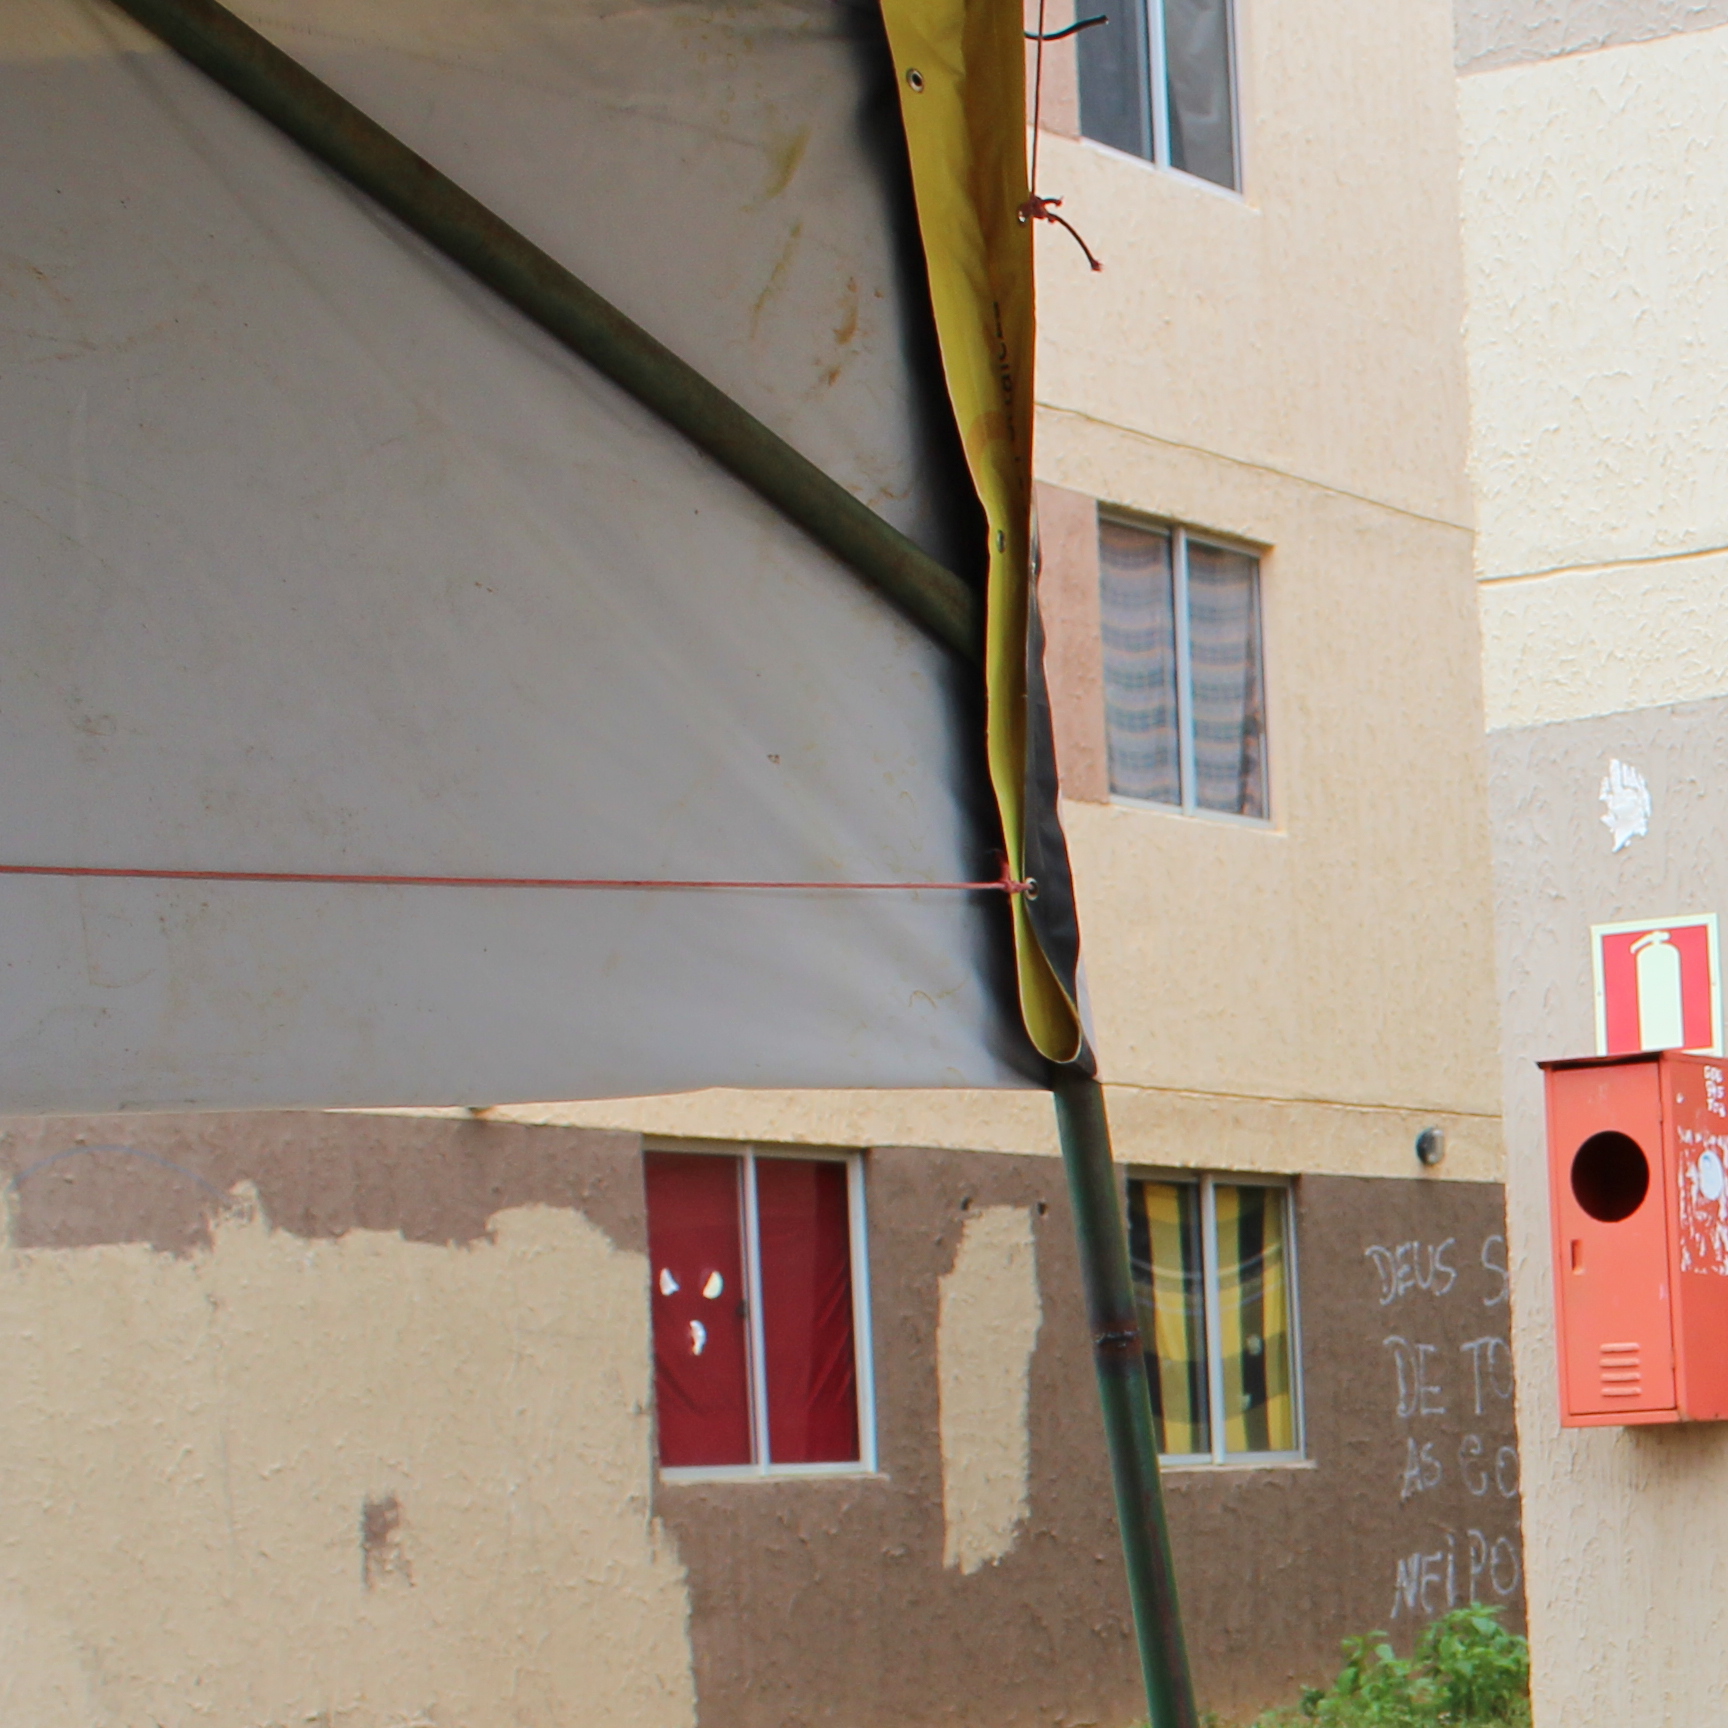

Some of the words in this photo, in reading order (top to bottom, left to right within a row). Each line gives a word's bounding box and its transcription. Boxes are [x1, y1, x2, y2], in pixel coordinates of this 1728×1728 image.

[1365, 1238, 1457, 1305] DEUS
[1383, 1334, 1446, 1418] DE
[1460, 1336, 1515, 1416] TO
[1402, 1437, 1443, 1500] AS
